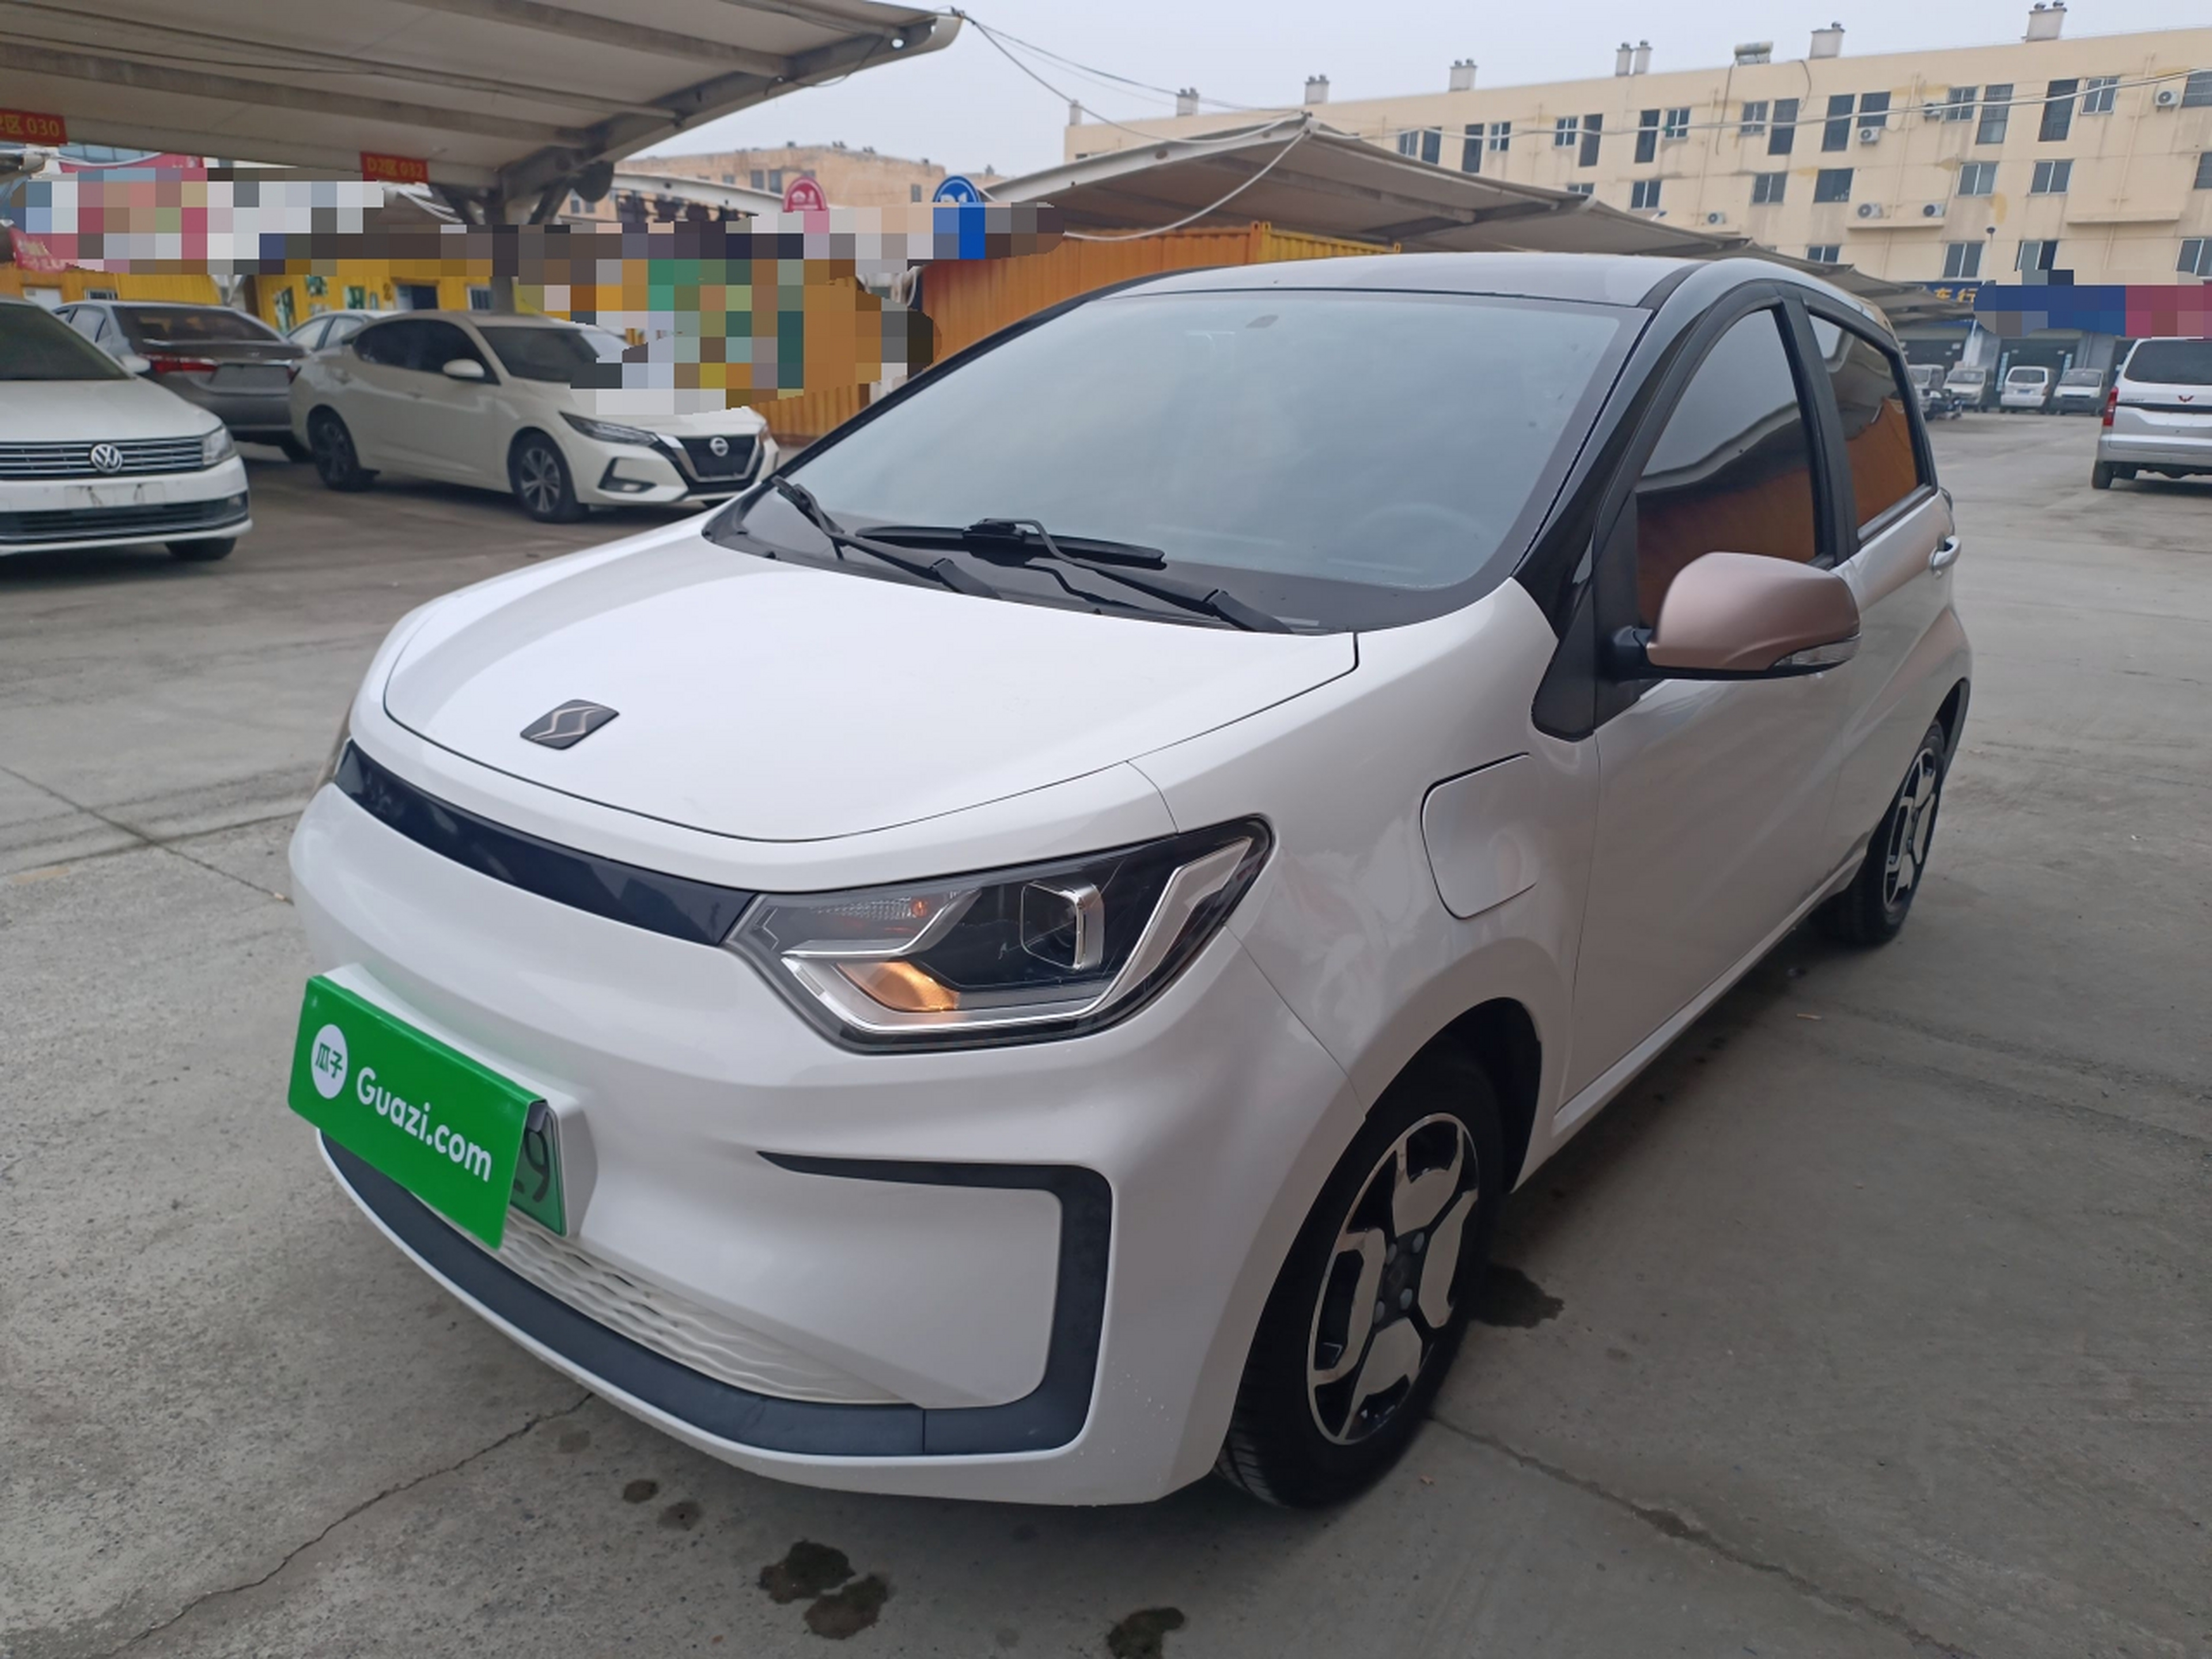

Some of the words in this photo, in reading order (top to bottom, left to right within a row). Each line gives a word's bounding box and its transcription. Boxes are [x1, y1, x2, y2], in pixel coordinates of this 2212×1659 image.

[26, 117, 59, 137] 030
[315, 1042, 343, 1079] 瓜子
[356, 1066, 492, 1183] Guazi.com
